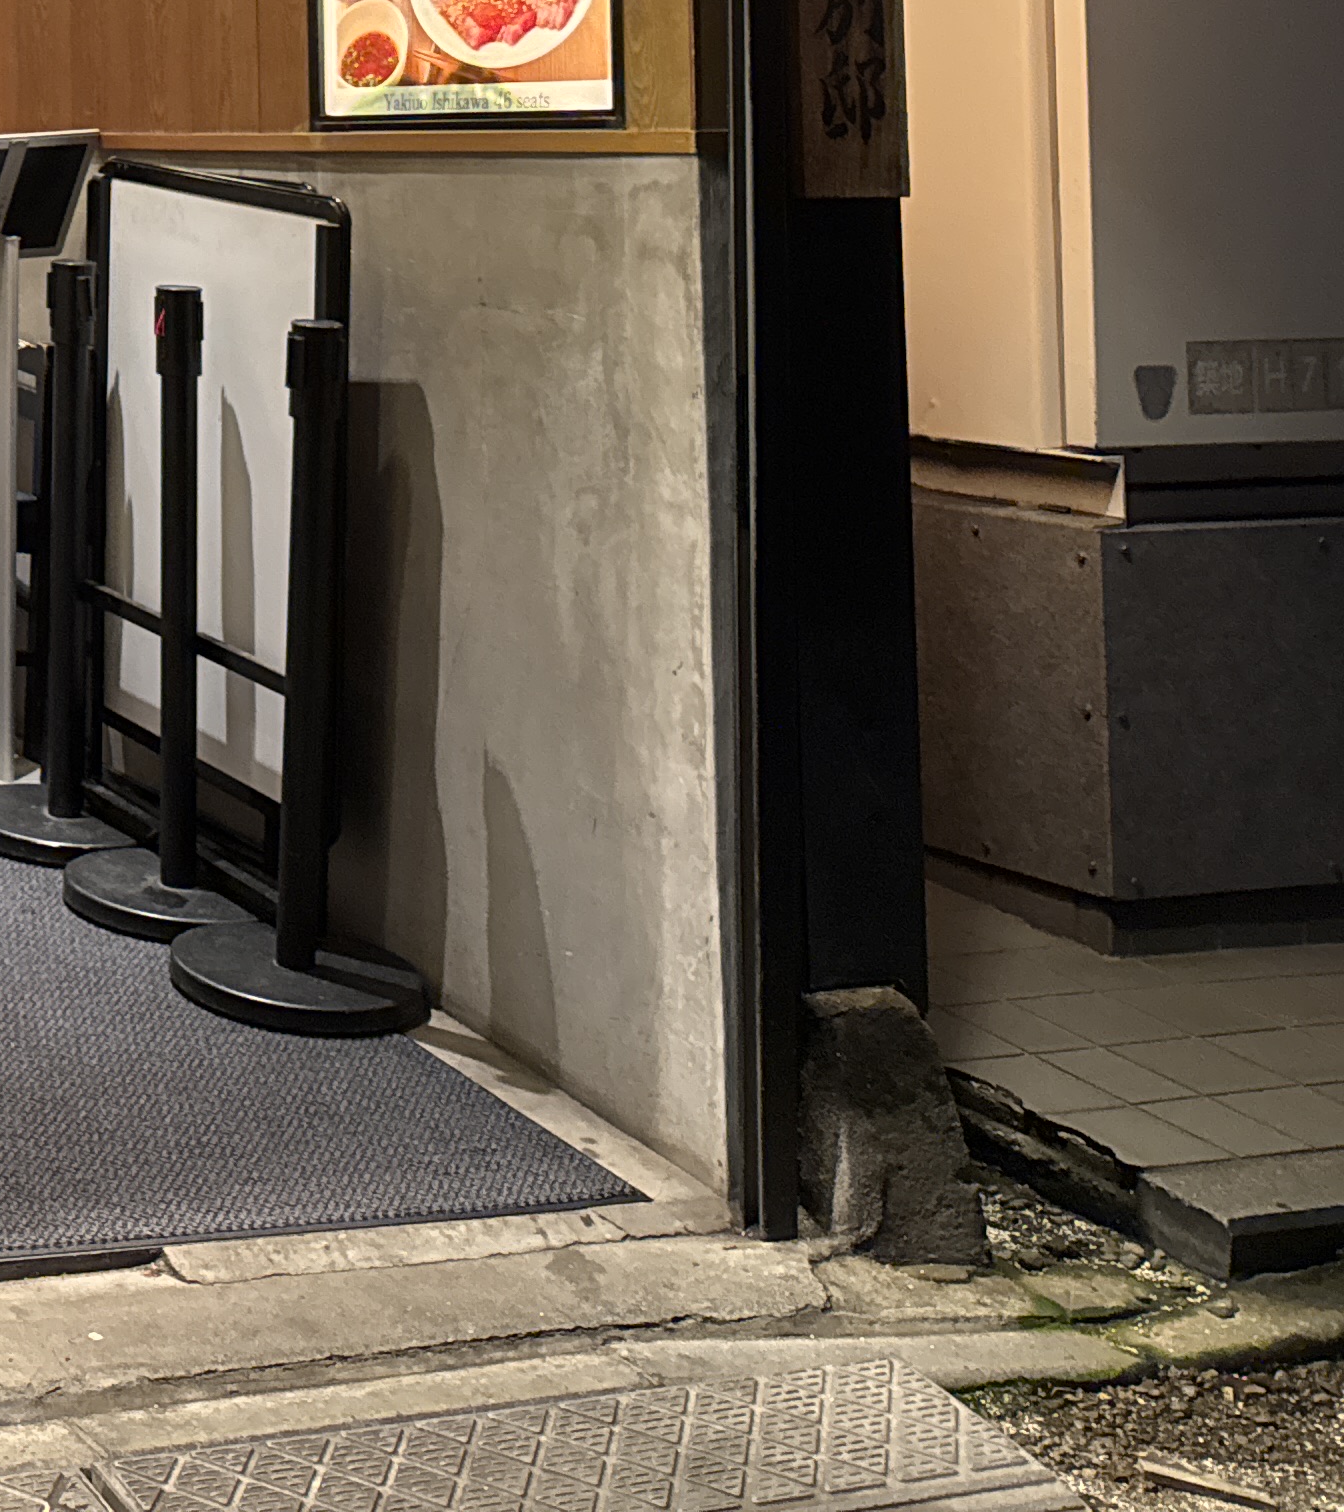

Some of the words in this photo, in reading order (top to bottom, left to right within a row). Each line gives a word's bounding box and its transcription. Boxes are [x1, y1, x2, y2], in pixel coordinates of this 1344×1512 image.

[383, 91, 428, 112] Yakiuo
[432, 90, 489, 111] Ishikawa
[516, 91, 551, 109] seats
